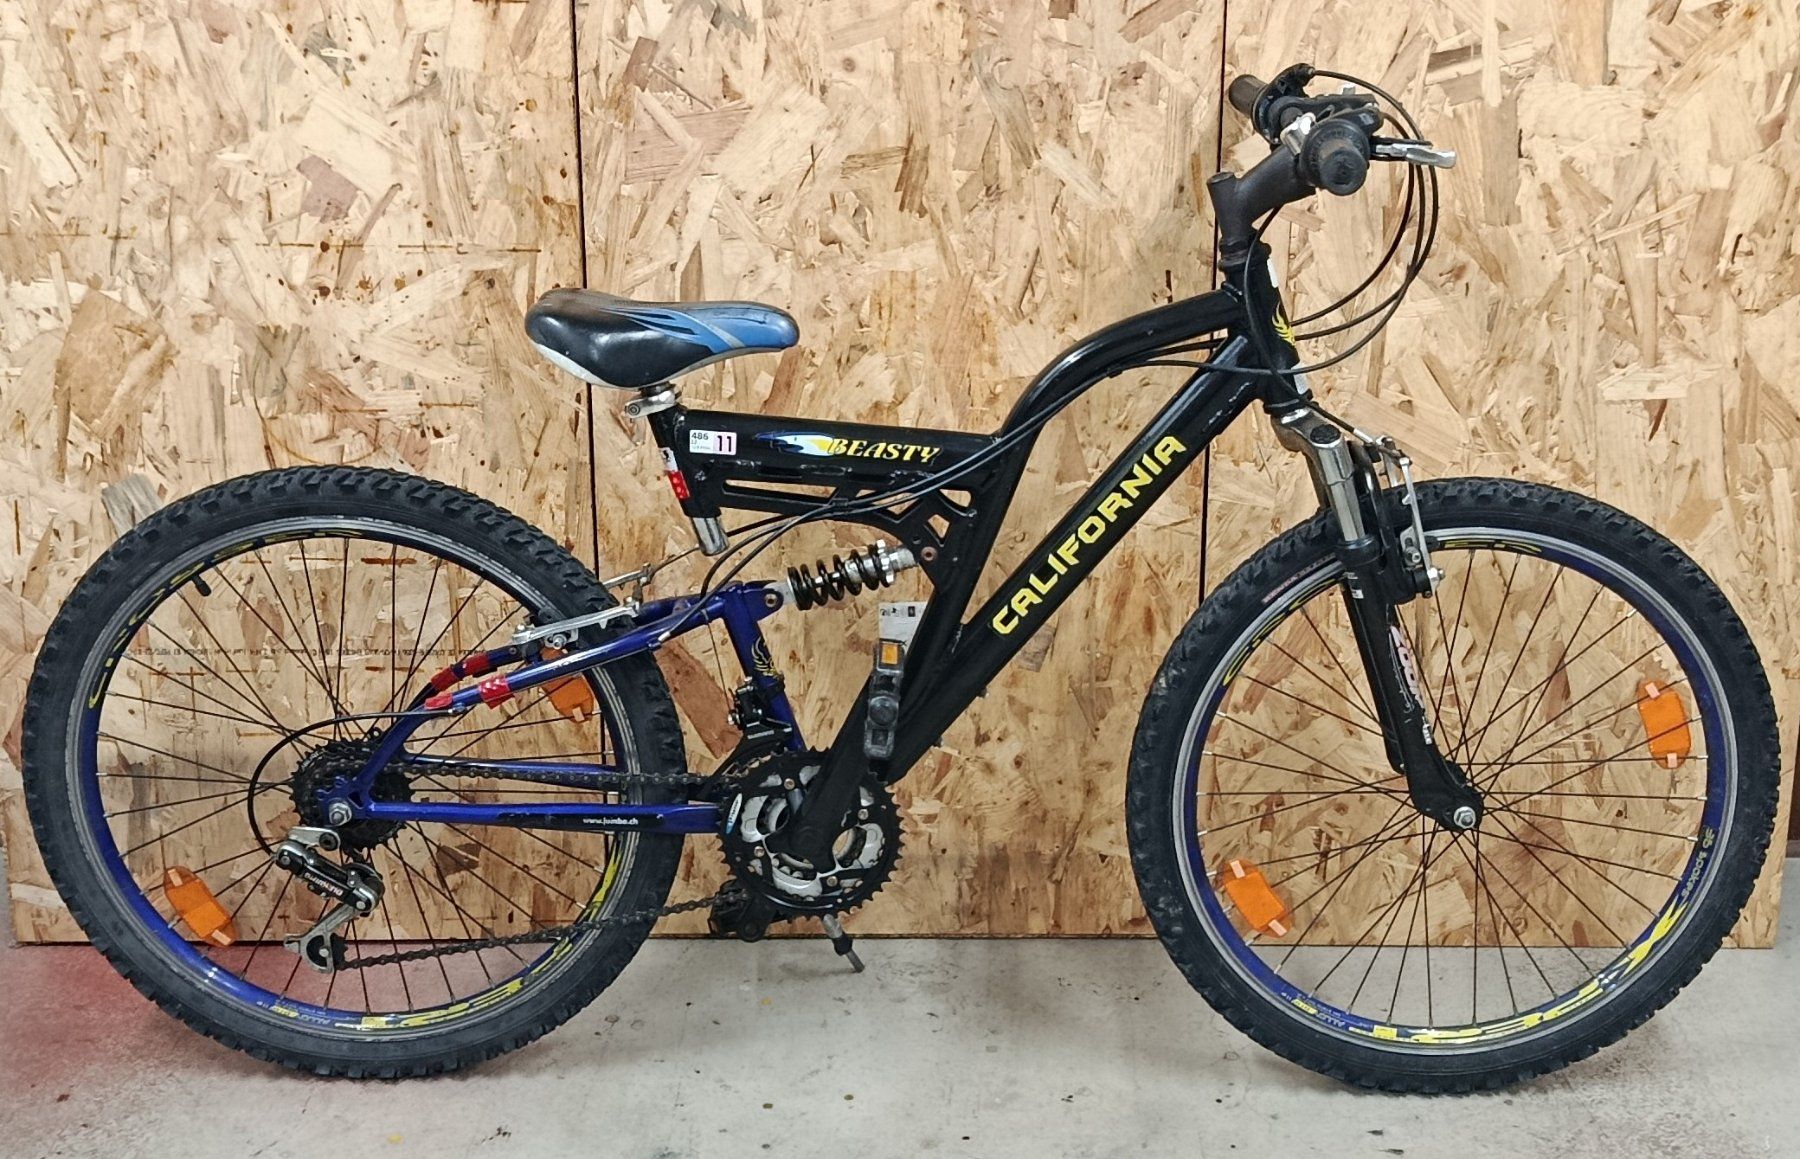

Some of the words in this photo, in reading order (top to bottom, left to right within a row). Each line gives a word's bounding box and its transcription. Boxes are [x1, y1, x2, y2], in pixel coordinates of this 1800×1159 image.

[717, 435, 732, 452] 11
[828, 437, 940, 464] BEASTY
[992, 436, 1187, 634] CALIFORNIA
[1681, 851, 1707, 897] spokes
